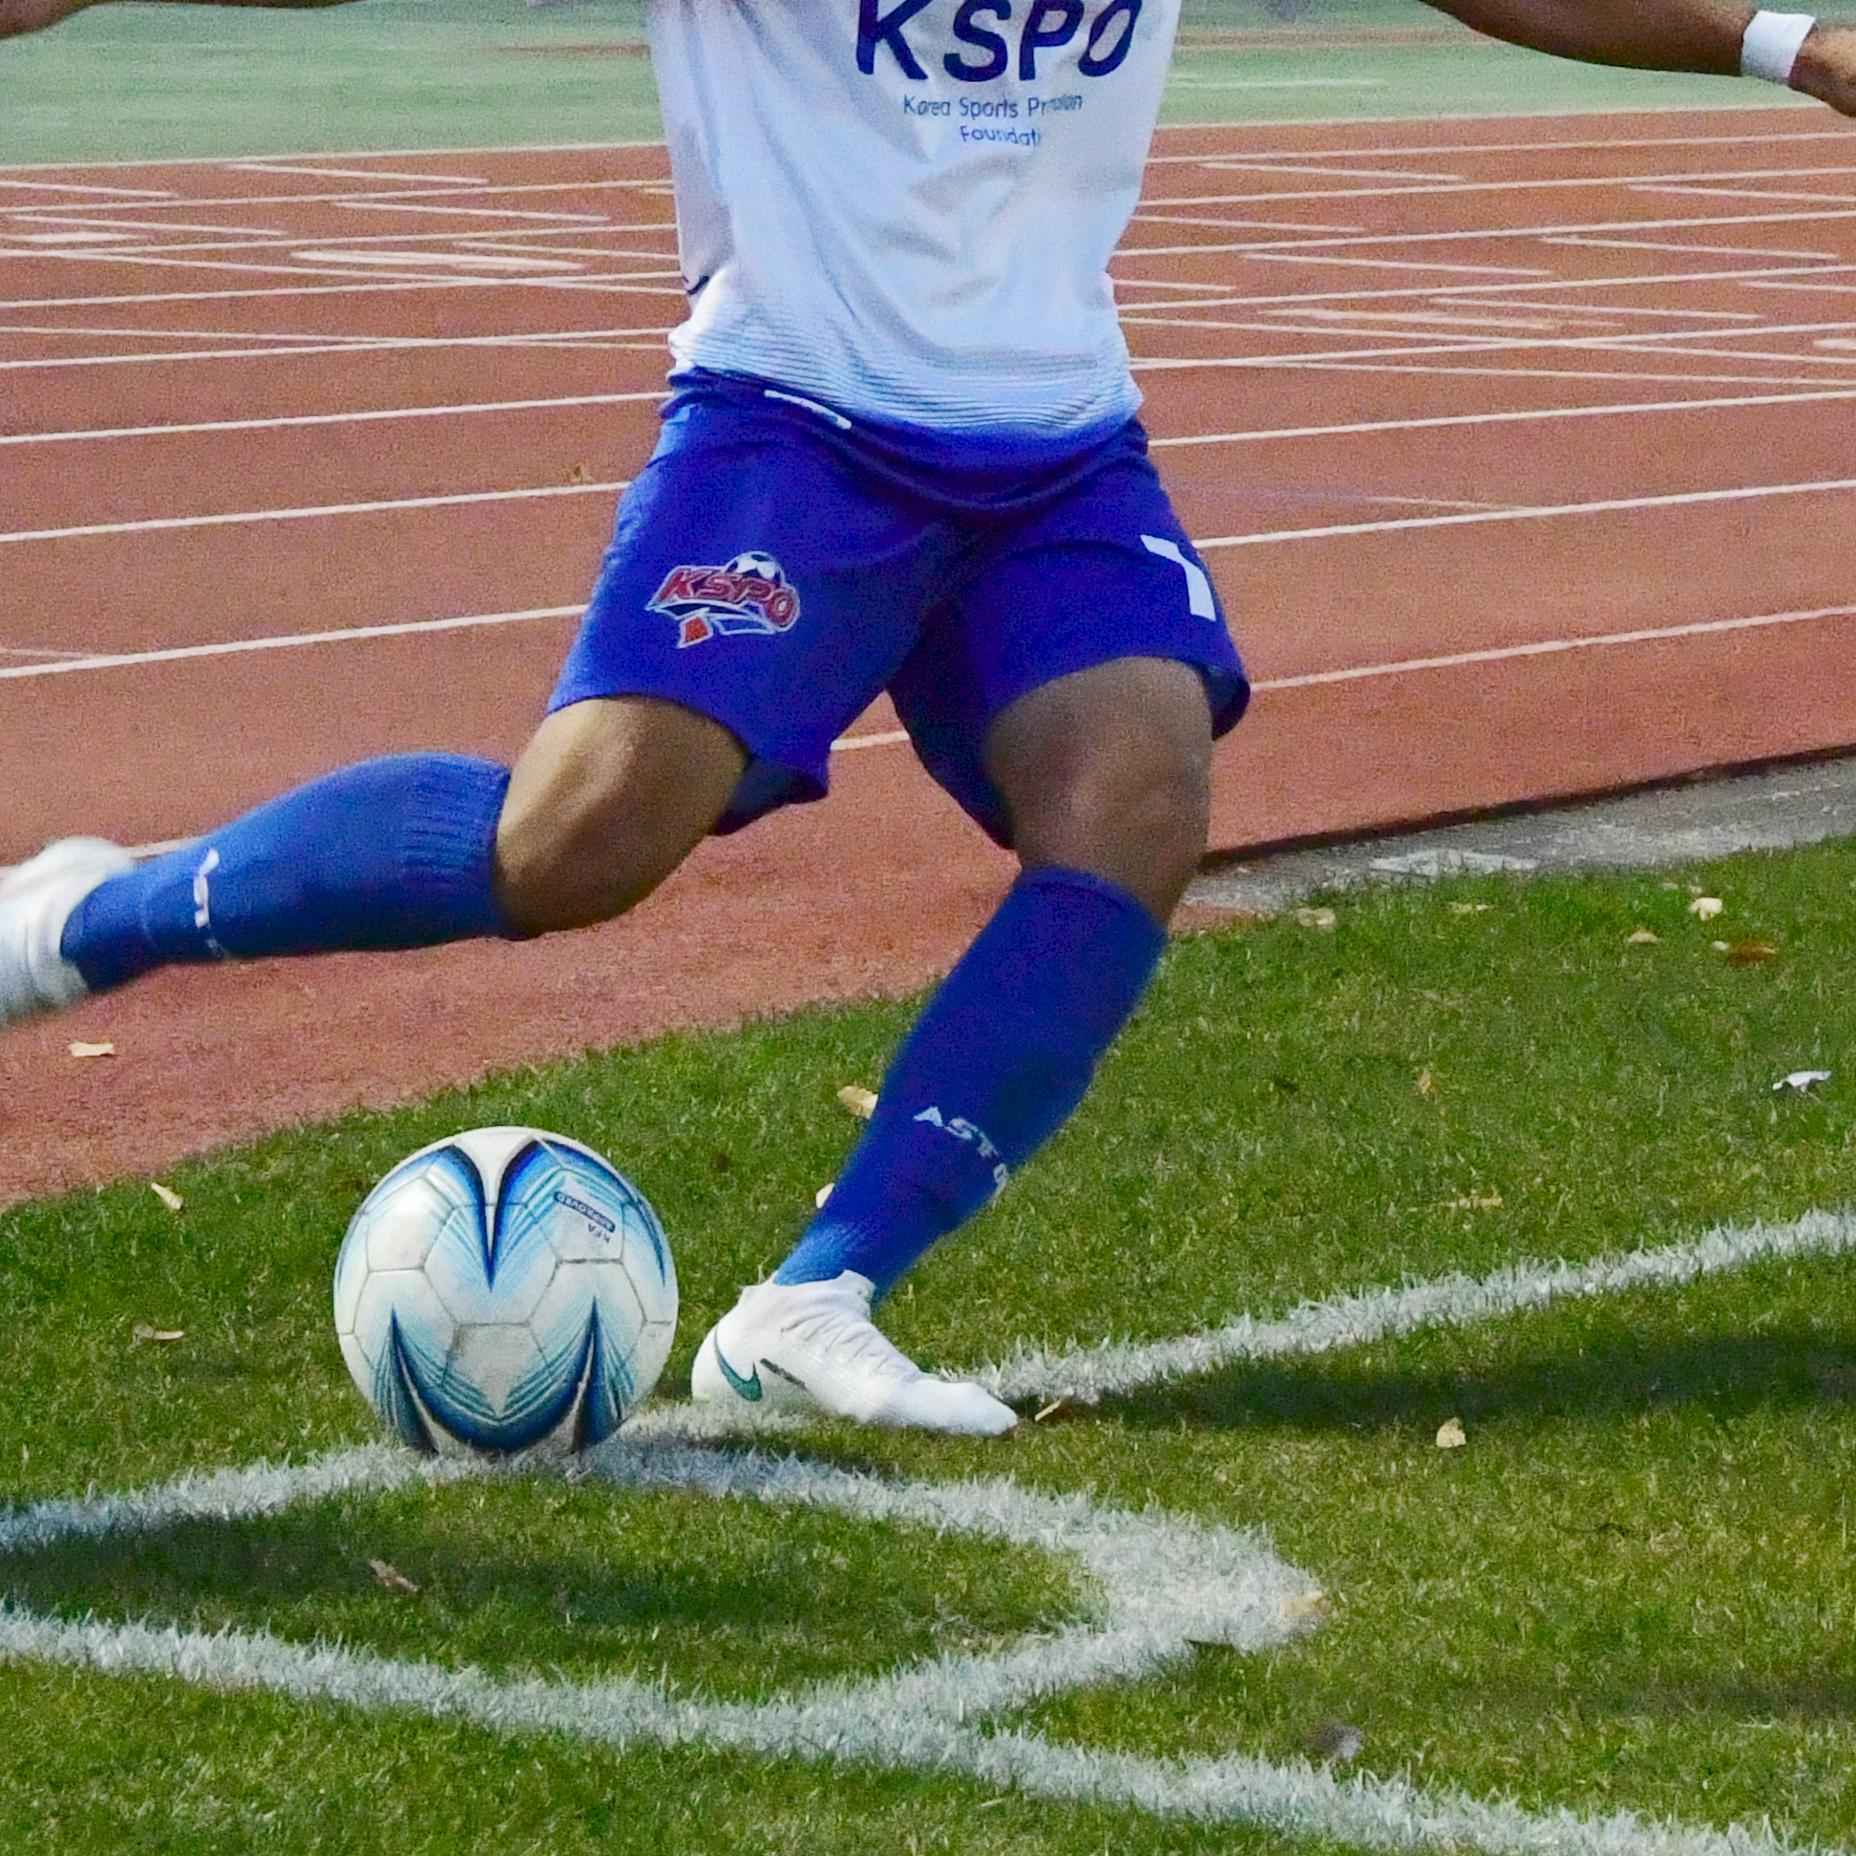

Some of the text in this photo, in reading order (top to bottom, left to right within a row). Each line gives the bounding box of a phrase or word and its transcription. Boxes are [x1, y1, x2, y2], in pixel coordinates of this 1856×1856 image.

[903, 94, 951, 117] Korea
[959, 96, 1019, 120] Sports
[645, 564, 801, 632] KSPO
